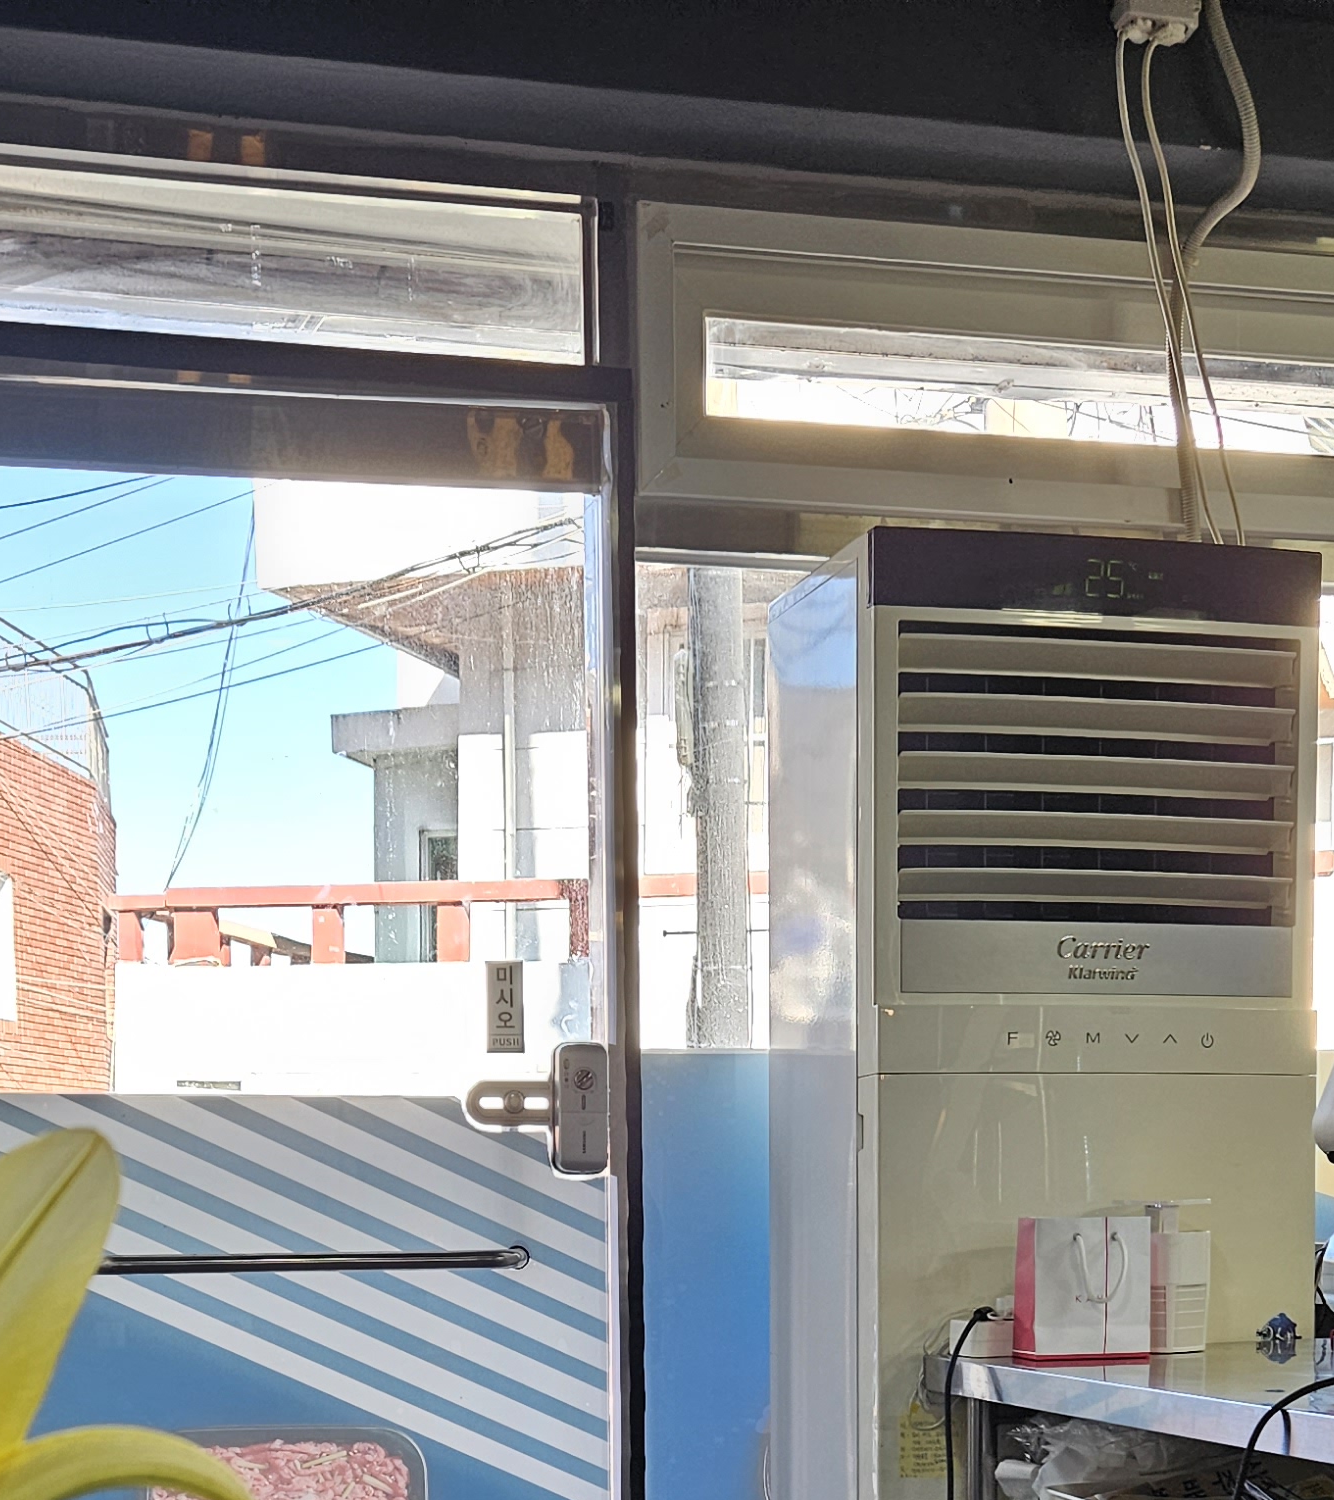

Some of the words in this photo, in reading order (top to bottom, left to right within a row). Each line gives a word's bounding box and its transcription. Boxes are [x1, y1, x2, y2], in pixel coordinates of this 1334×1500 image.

[1085, 559, 1124, 598] 25
[1057, 935, 1150, 960] Carrier
[495, 964, 516, 1029] 미시오
[1007, 1031, 1019, 1046] F
[1085, 1032, 1101, 1044] M
